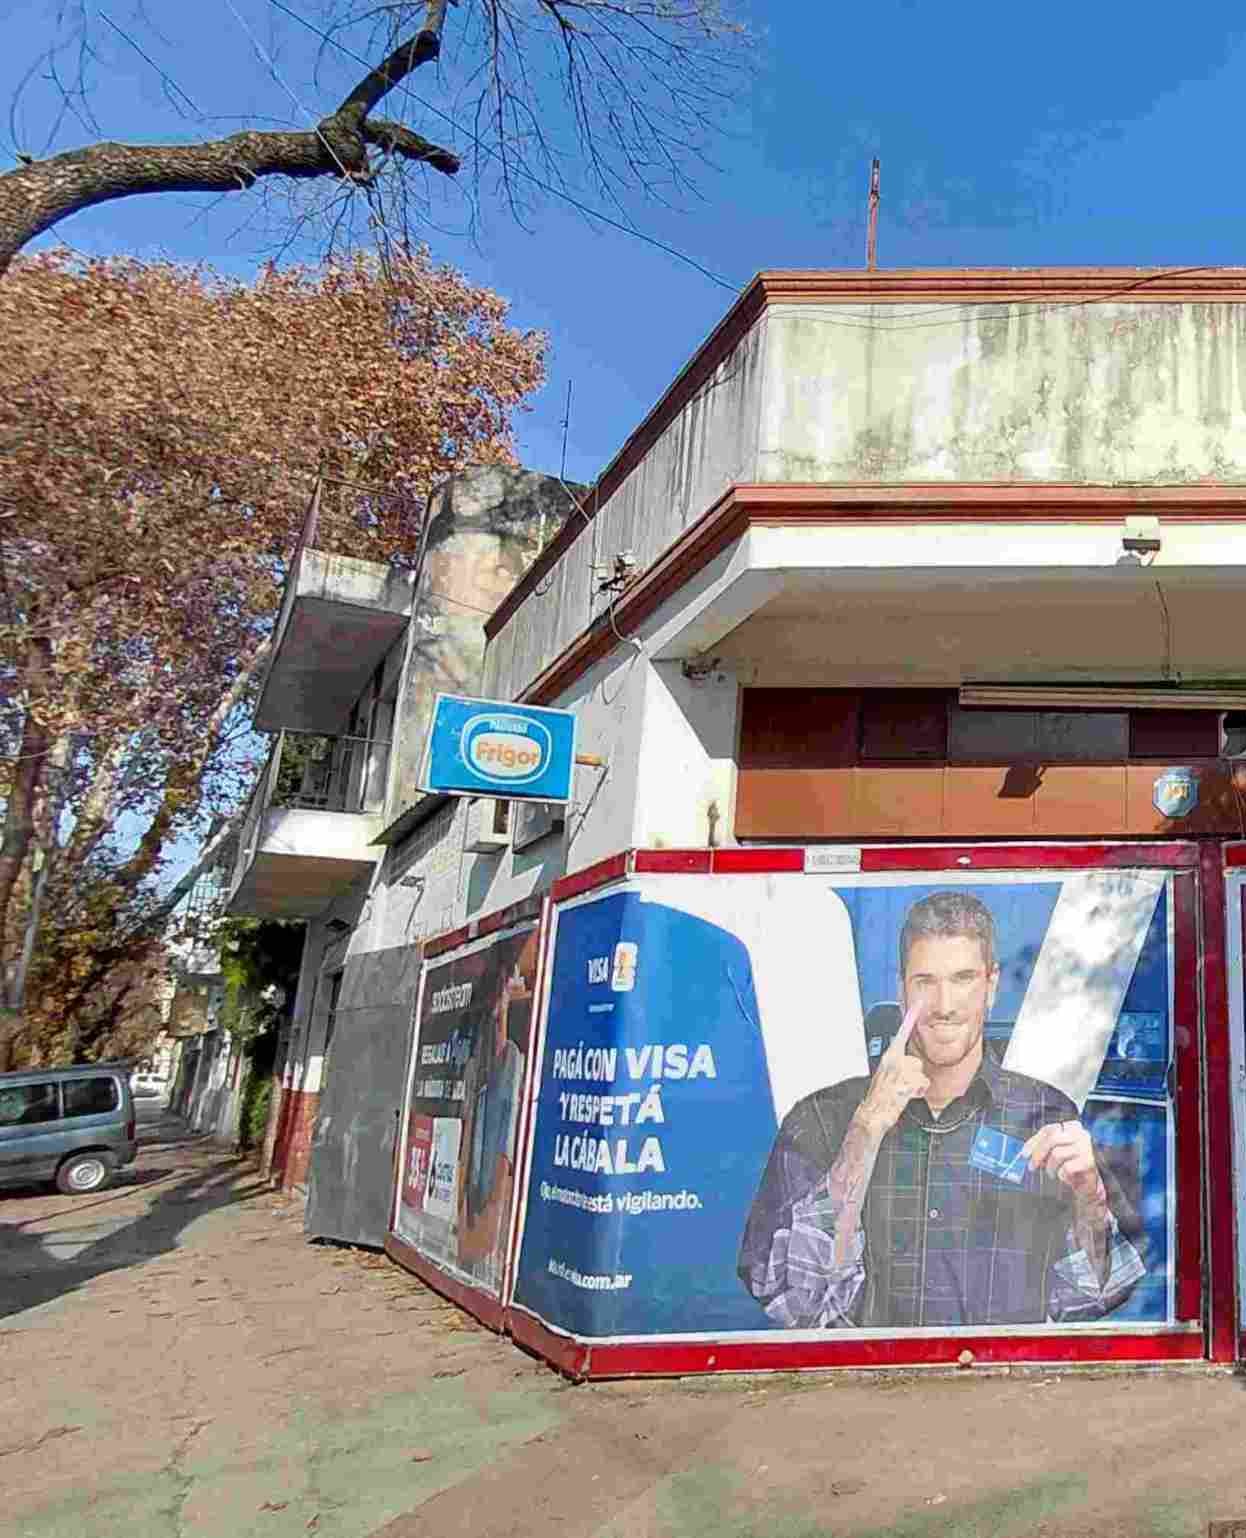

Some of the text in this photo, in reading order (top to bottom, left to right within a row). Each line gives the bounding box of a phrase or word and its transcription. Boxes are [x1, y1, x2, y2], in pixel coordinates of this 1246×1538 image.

[475, 742, 538, 767] Frigor
[552, 1040, 718, 1082] PAGÁ CON VISA
[559, 1083, 666, 1126] Y RESPETÁ
[554, 1129, 666, 1176] LA CÁBALA
[616, 1188, 704, 1216] vigilando.
